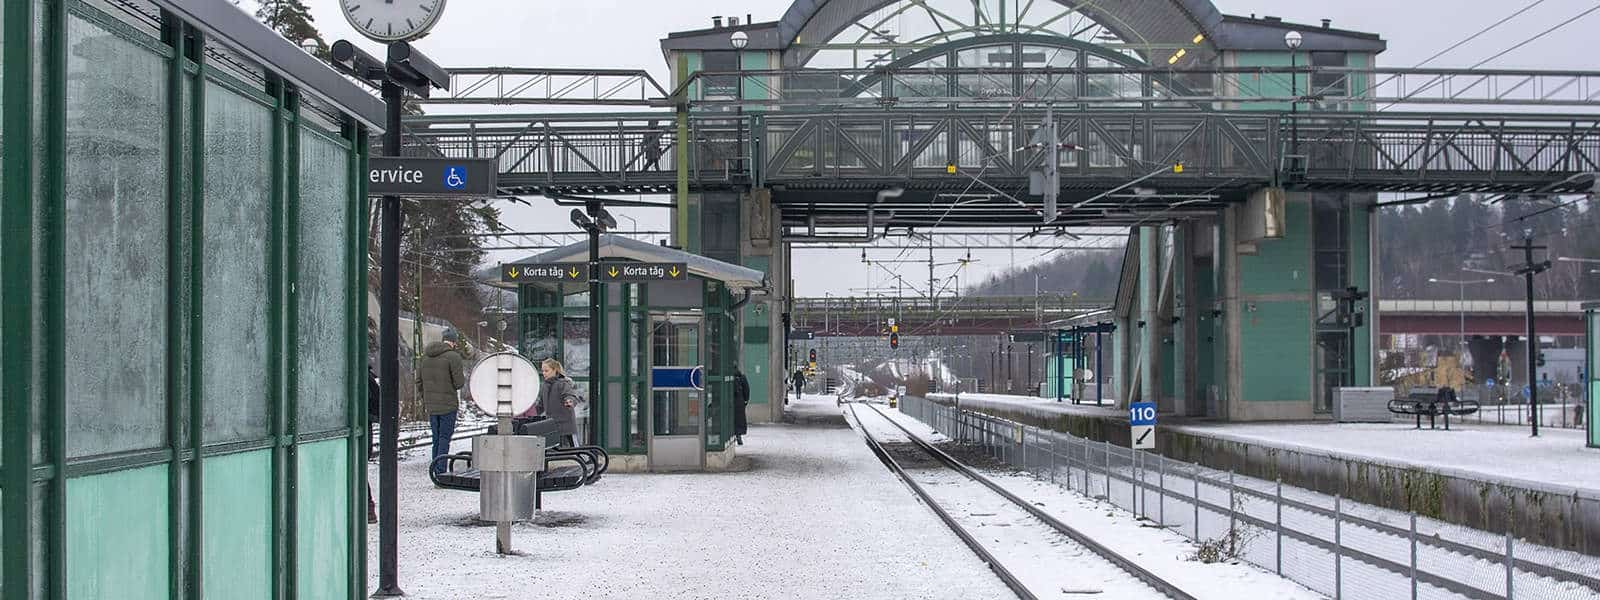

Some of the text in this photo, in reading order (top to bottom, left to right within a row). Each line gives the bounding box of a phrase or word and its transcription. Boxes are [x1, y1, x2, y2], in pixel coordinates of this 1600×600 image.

[523, 266, 564, 279] Korta tåg
[623, 265, 664, 278] Korta tåg
[1130, 407, 1155, 421] 110
